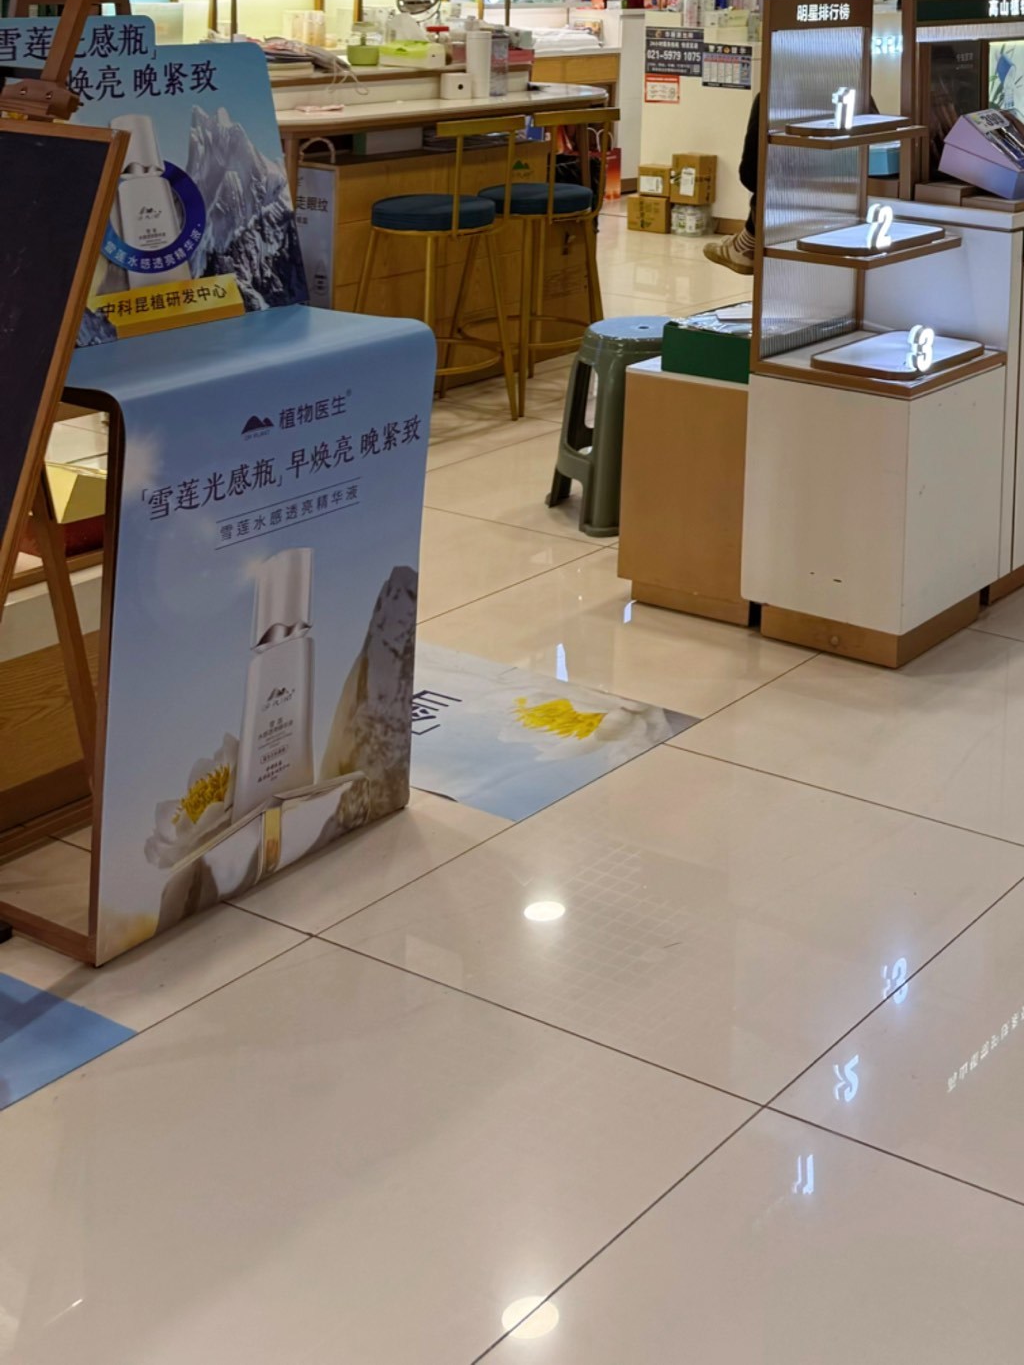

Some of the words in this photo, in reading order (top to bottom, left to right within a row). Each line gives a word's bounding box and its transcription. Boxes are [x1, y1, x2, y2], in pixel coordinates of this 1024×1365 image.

[797, 3, 850, 22] 明星排行榜
[133, 60, 219, 100] 晚紧致
[870, 204, 894, 249] 2
[101, 282, 228, 319] 中科昆植研发中心
[910, 326, 935, 372] 3
[278, 394, 347, 431] 植物医生
[359, 413, 423, 456] 晚紧致
[220, 485, 359, 542] 雪莲水感透亮精华液
